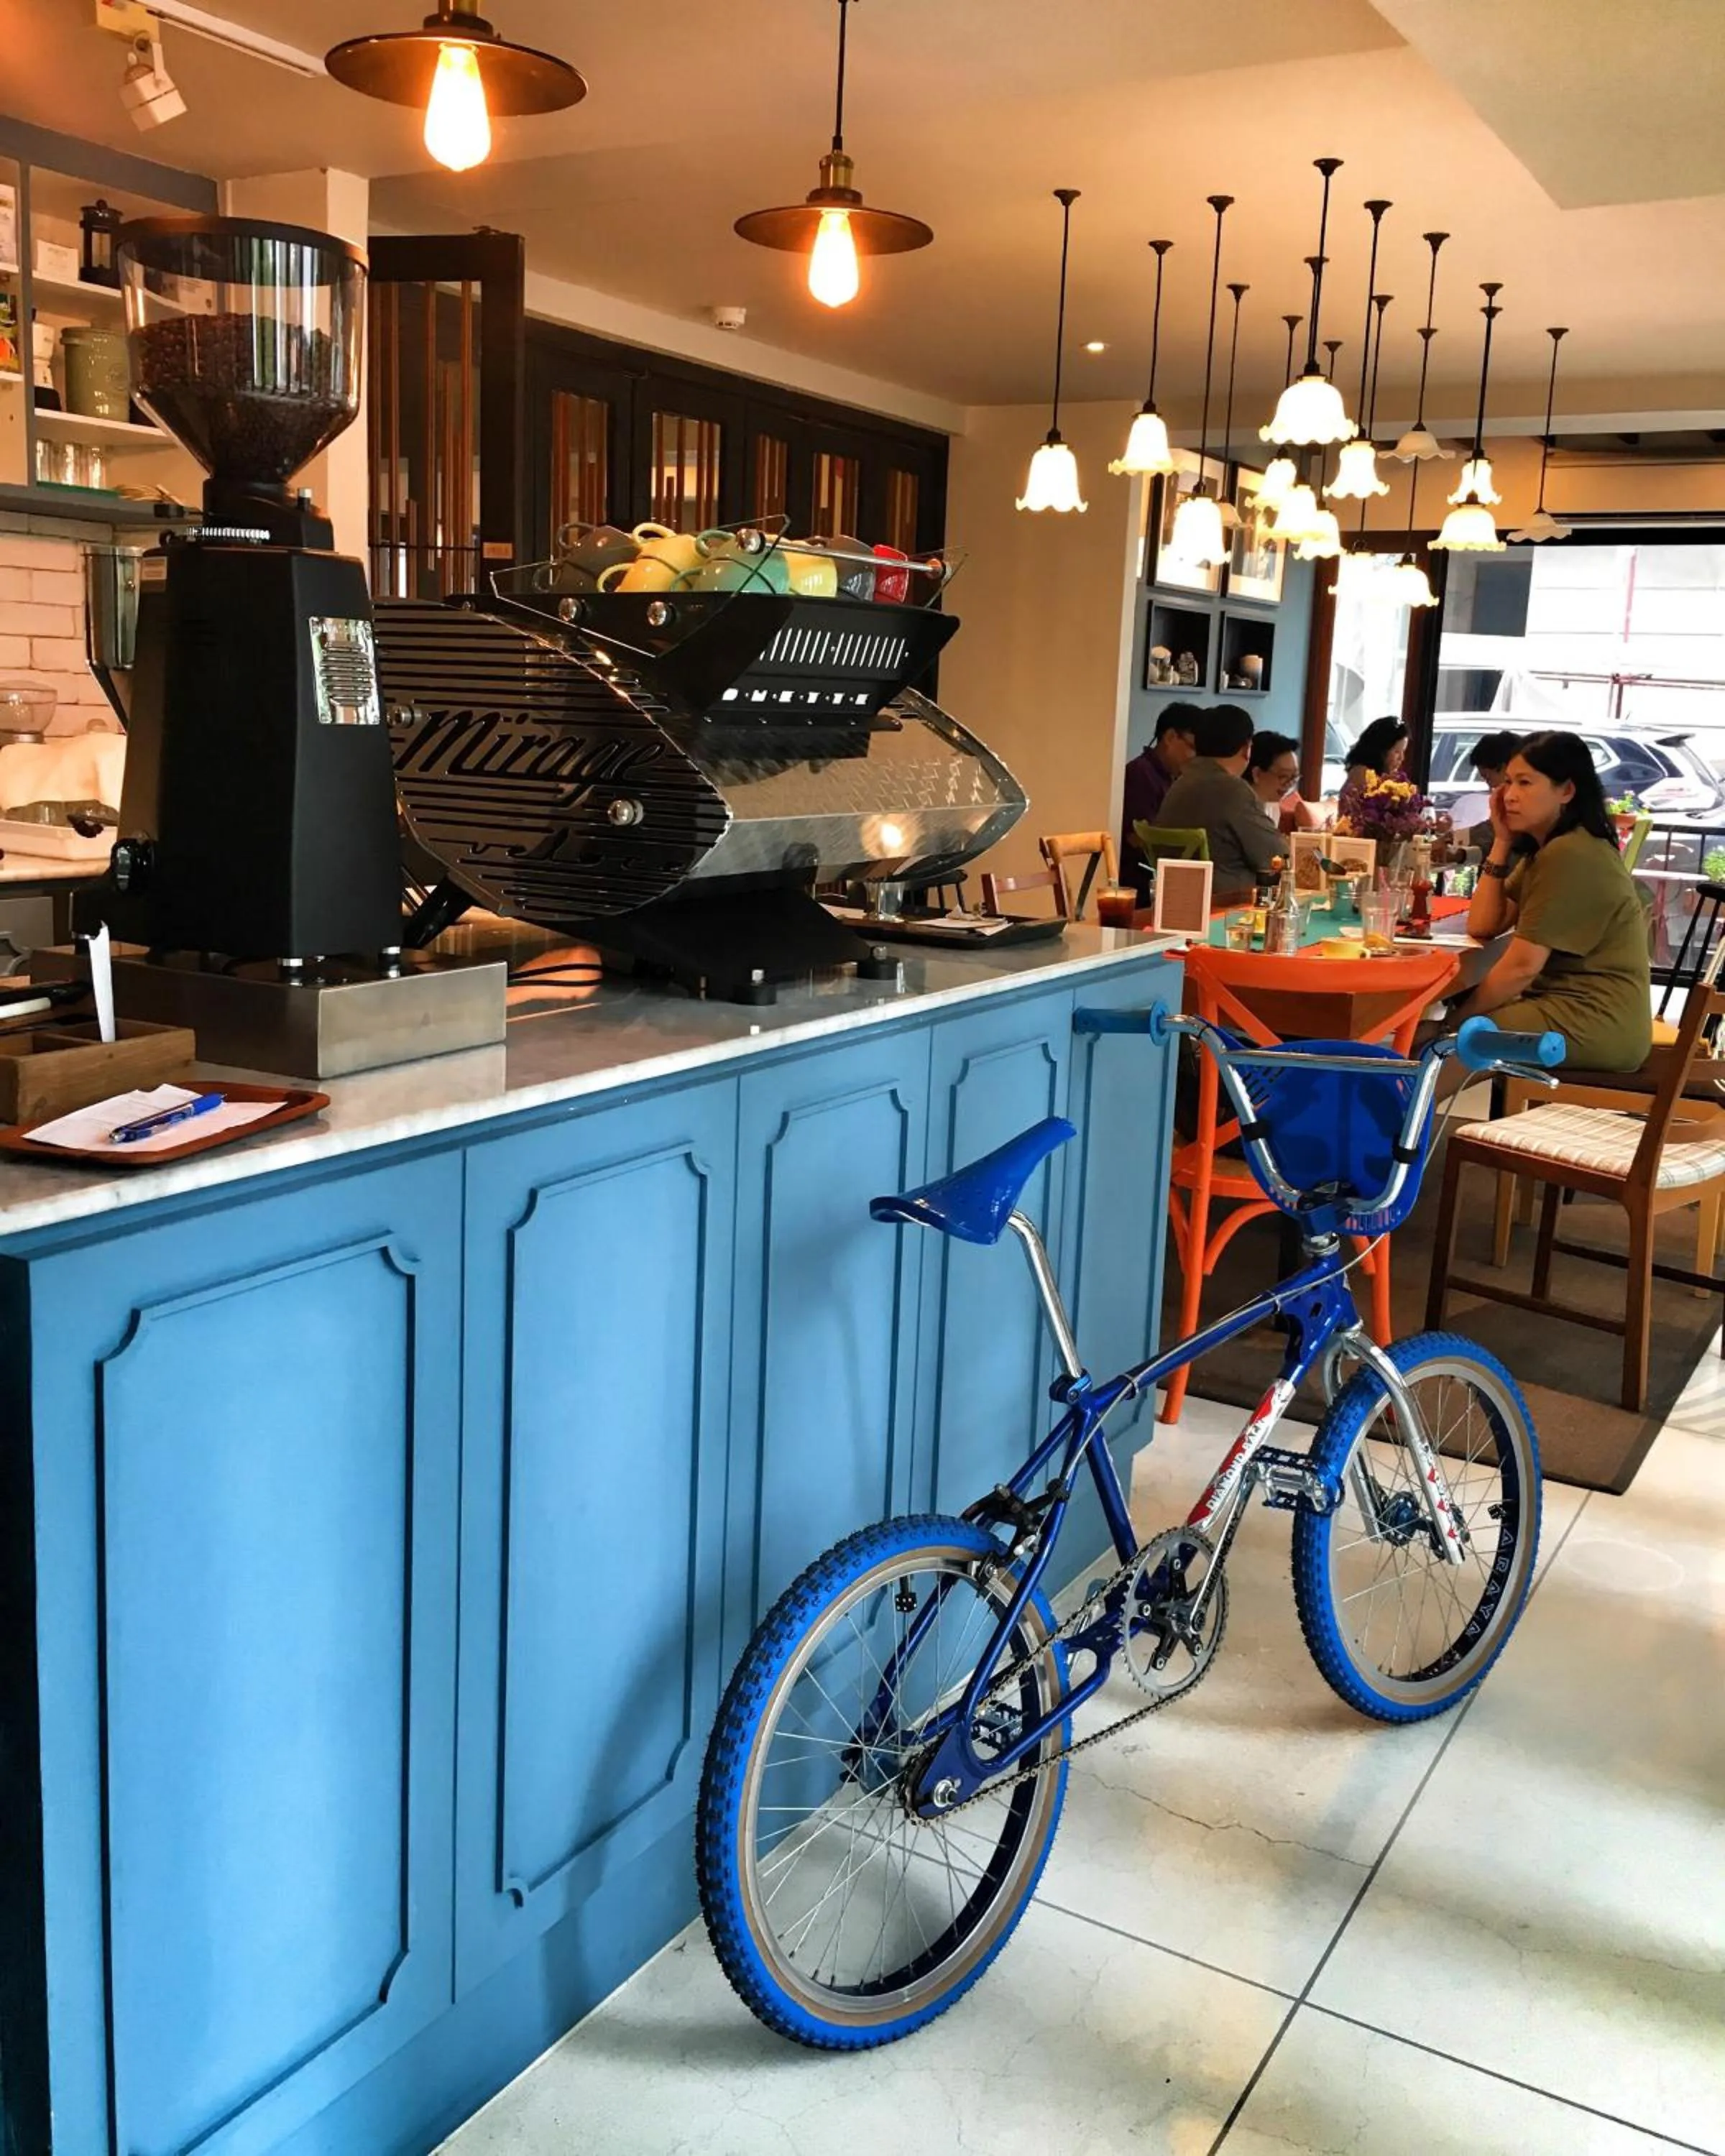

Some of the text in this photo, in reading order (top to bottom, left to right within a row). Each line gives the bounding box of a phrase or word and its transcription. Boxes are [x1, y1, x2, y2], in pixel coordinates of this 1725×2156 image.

[394, 709, 665, 808] Mirage
[1206, 1452, 1244, 1510] DIAMOND
[1465, 1529, 1514, 1637] ARAYA
